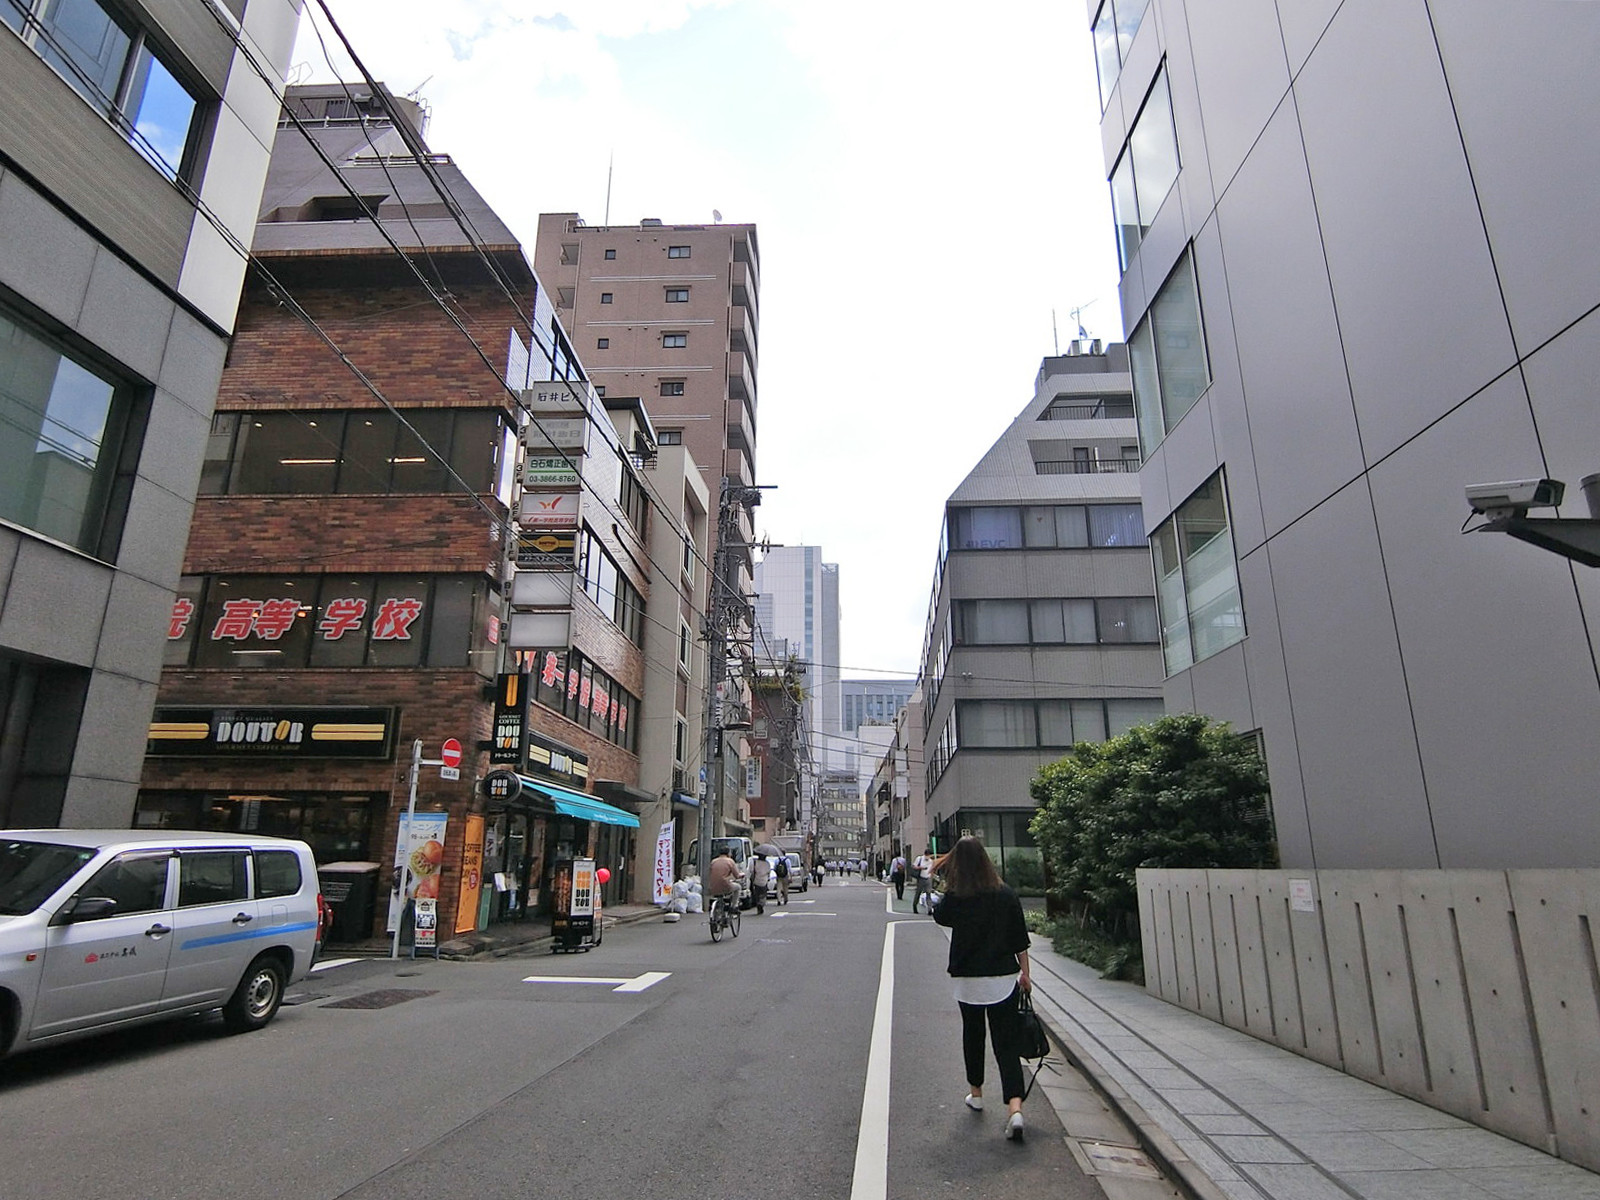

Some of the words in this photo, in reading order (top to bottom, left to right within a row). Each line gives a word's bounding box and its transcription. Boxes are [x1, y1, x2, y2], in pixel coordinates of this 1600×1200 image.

[538, 392, 580, 402] 石井ビル
[529, 475, 576, 483] 03-3866-8760
[216, 720, 304, 742] DOUTOR
[498, 725, 520, 737] DOU
[496, 737, 519, 748] TOR
[576, 889, 590, 898] DOU
[575, 898, 590, 907] TOR
